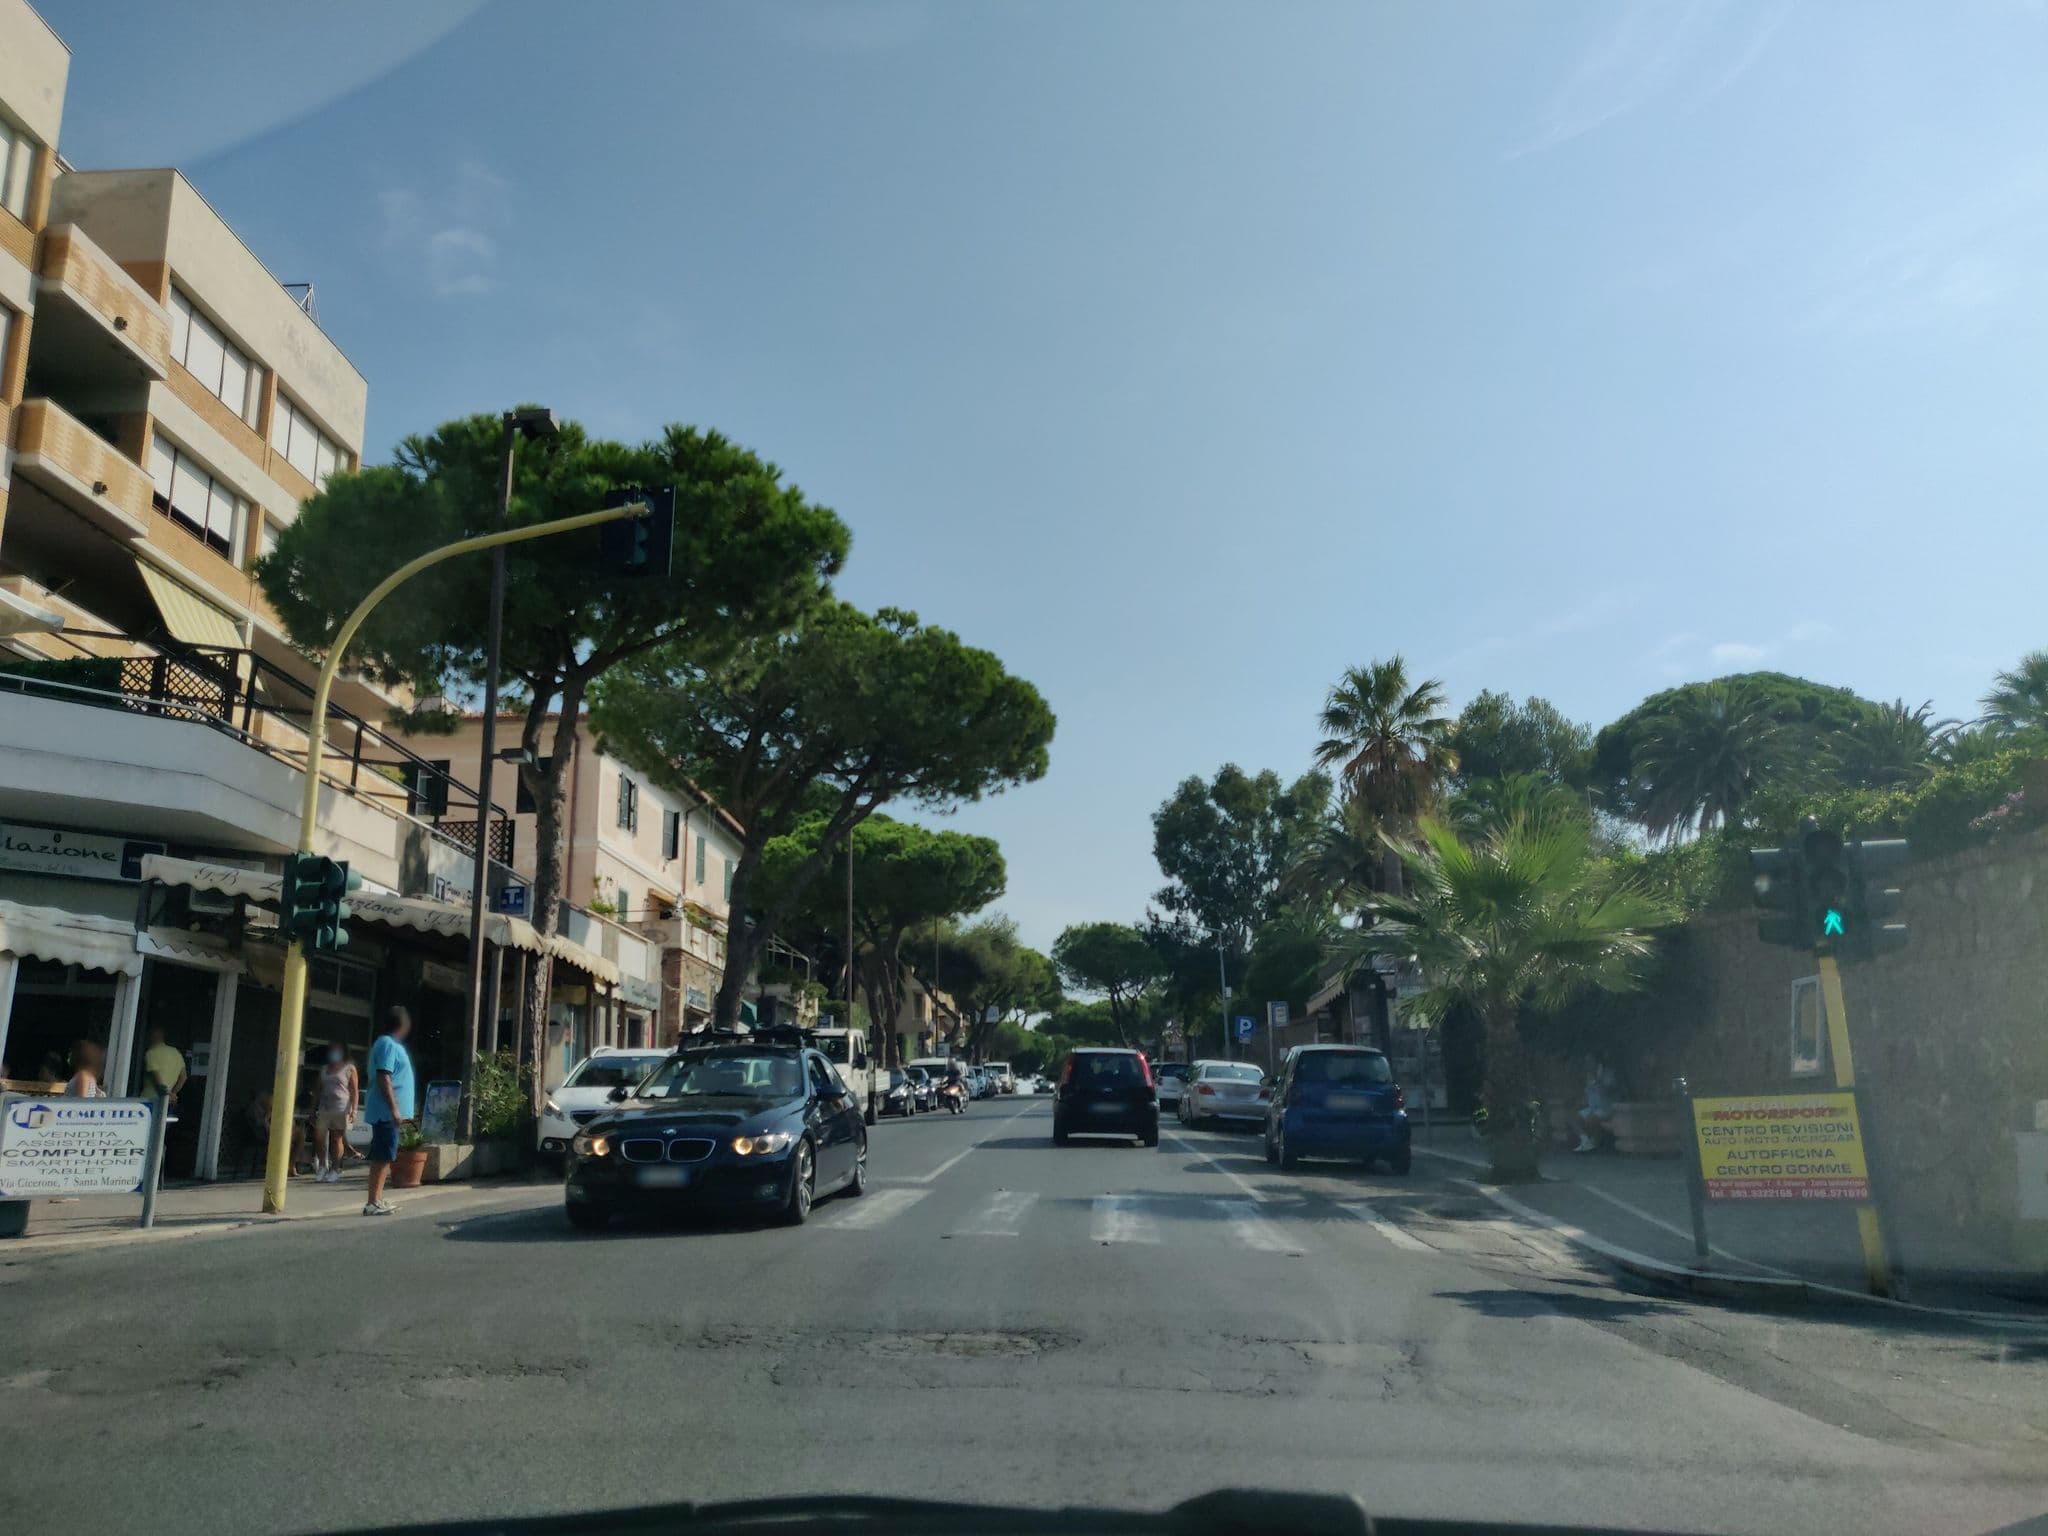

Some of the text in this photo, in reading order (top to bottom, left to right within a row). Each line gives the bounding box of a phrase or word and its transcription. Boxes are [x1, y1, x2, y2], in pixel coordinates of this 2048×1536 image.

[1701, 1122, 1854, 1136] CENTRO REVISIONI
[17, 1139, 135, 1147] ASSISTENZA
[1704, 1136, 1737, 1145] AUTO
[1744, 1135, 1779, 1144] MOTO
[3, 1149, 145, 1158] COMPUTER
[1727, 1148, 1836, 1160] AUTOFFICINA
[6, 1159, 139, 1167] SMARTPHONE
[1717, 1163, 1852, 1176] CENTRO GOMME
[73, 1177, 98, 1187] Santa
